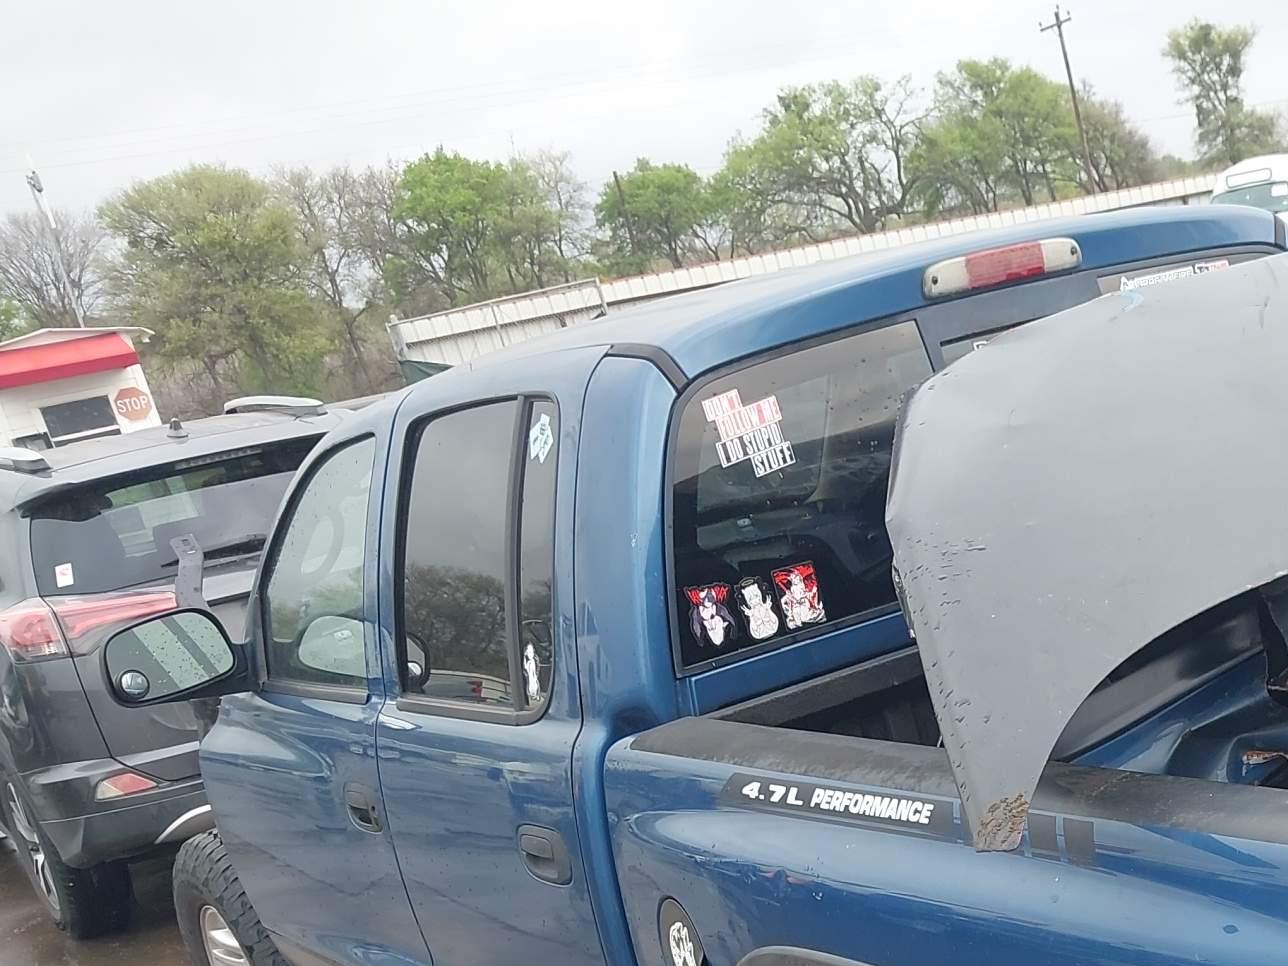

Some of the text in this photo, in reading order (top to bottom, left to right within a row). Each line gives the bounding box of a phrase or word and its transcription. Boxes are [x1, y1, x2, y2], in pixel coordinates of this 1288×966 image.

[117, 395, 148, 413] STOP
[717, 398, 781, 441] FOLLOW ME
[726, 438, 745, 463] DO
[743, 423, 783, 455] STUPID
[754, 444, 794, 475] STUFF
[741, 782, 936, 825] 4.7L PERFORMANCE
